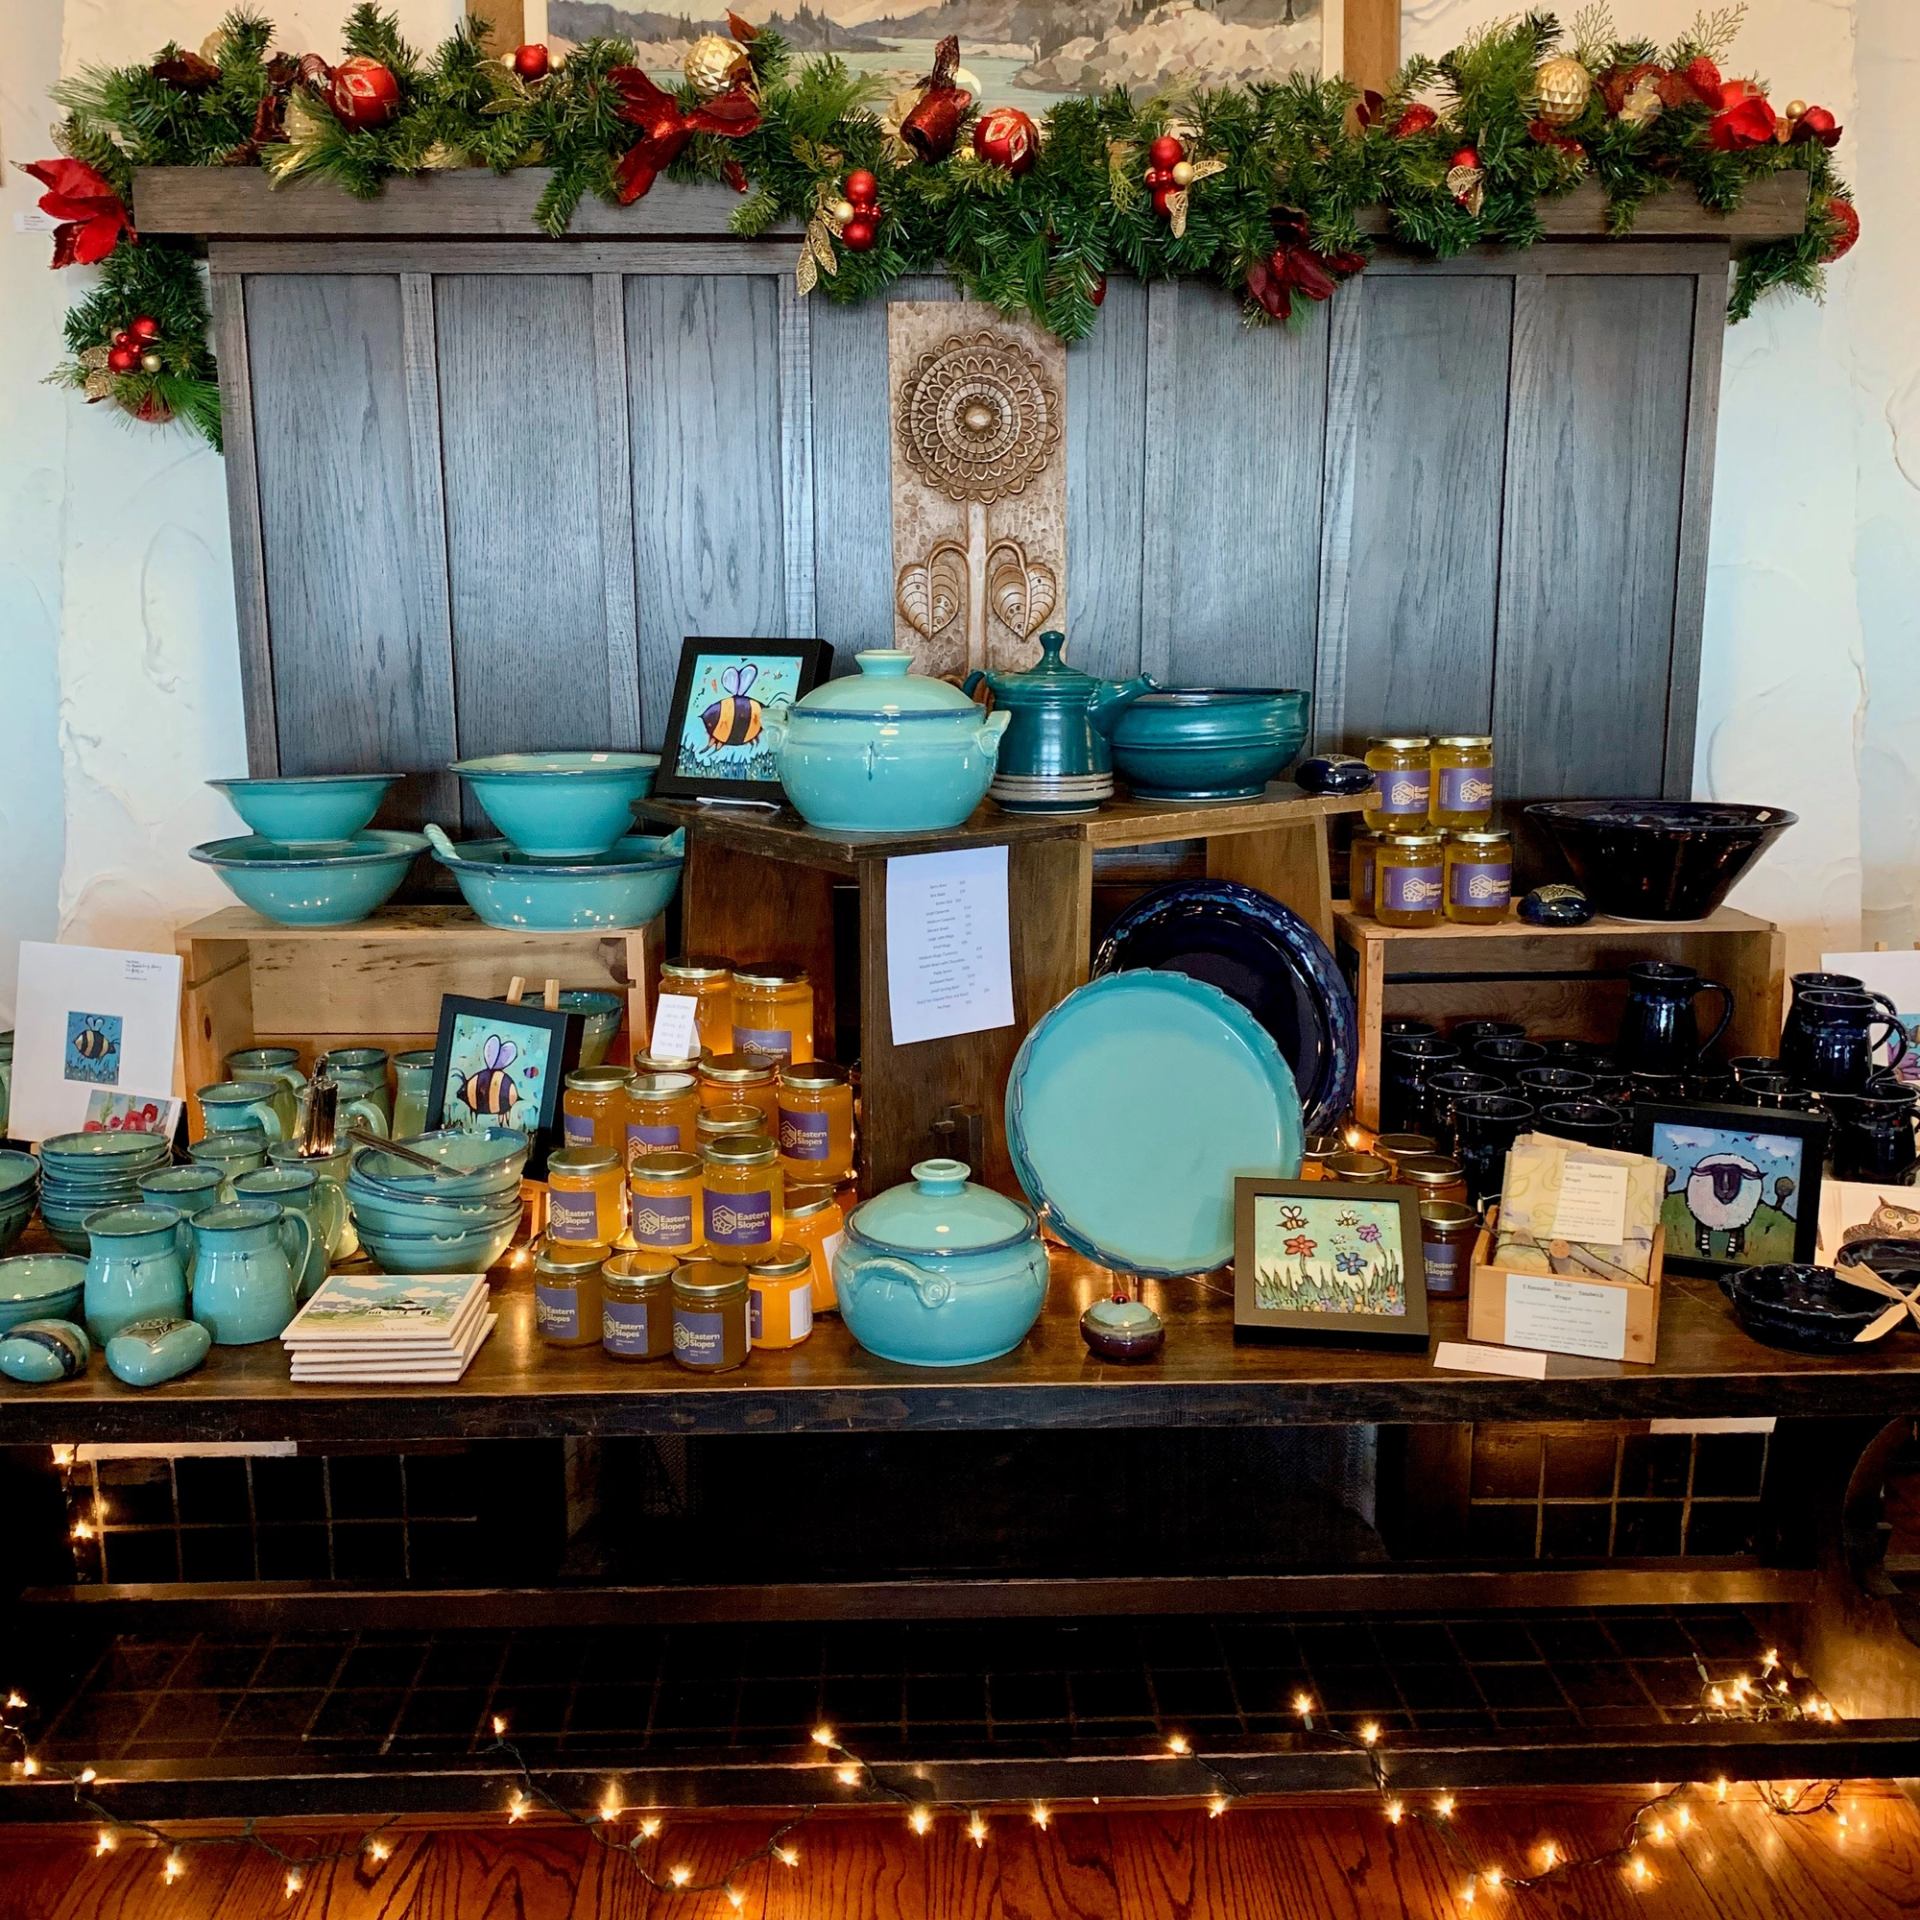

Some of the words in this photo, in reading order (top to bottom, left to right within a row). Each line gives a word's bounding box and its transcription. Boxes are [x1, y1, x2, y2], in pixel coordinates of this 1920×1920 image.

[761, 1046, 788, 1054] Eastern
[798, 1130, 827, 1138] Eastern
[797, 1138, 822, 1146] Slopes
[647, 1144, 679, 1153] Eastern
[565, 1209, 595, 1217] Eastern
[737, 1211, 770, 1221] Eastern
[565, 1217, 590, 1226] Slopes
[660, 1215, 690, 1223] Eastern
[660, 1222, 686, 1231] Slopes
[737, 1220, 765, 1230] Slopes
[1428, 1260, 1458, 1269] Eastern
[1428, 1268, 1454, 1276] Slopes
[547, 1306, 576, 1316] Eastern
[547, 1314, 571, 1322] Slopes
[615, 1321, 645, 1330] Eastern
[615, 1329, 640, 1338] Slopes
[689, 1331, 720, 1340] Eastern
[689, 1340, 716, 1349] Slopes
